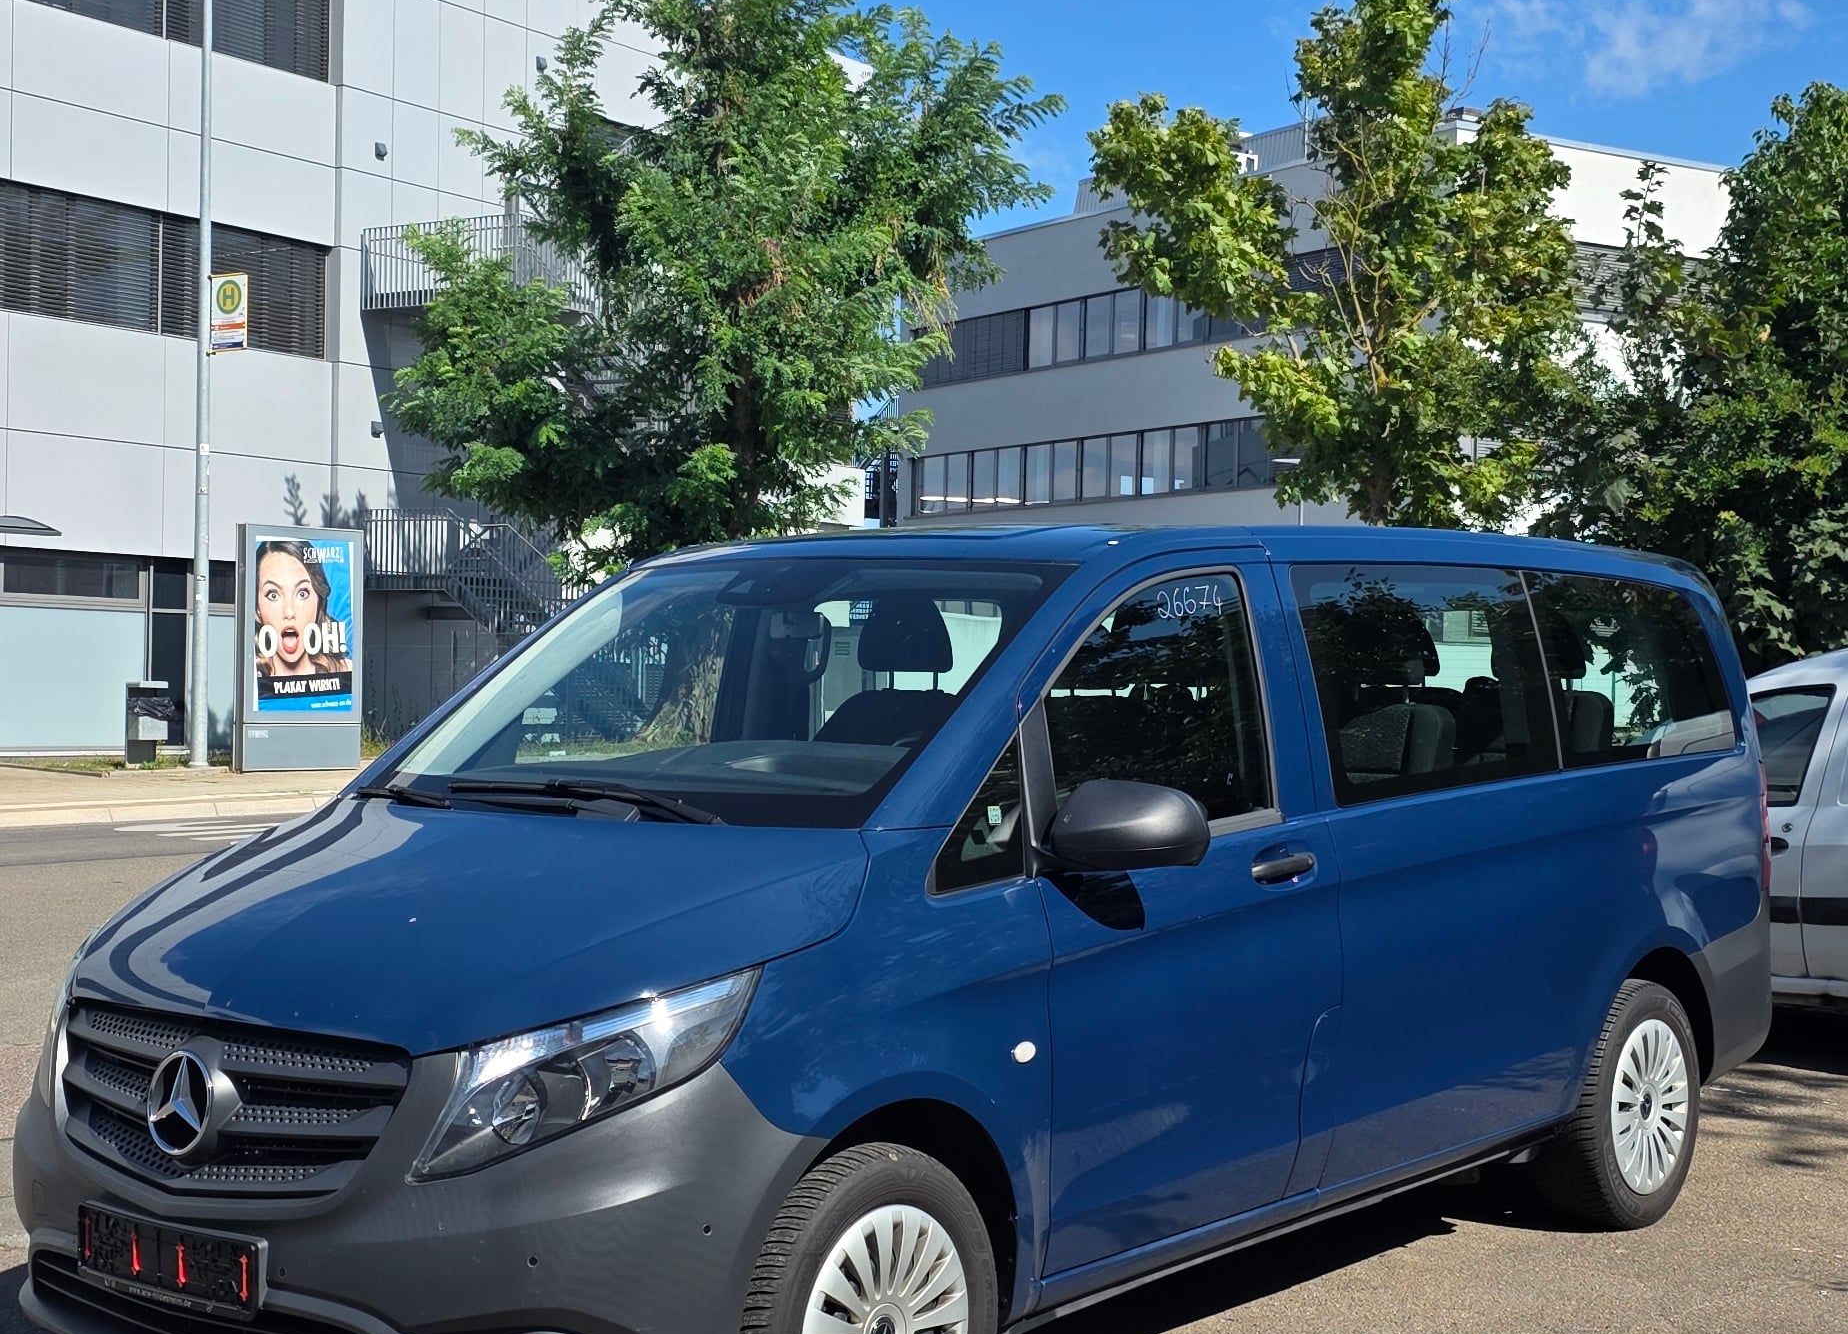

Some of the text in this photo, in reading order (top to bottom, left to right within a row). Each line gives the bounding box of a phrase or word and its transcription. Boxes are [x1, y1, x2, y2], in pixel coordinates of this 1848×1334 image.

[223, 287, 235, 307] H
[303, 547, 340, 563] SCHWARZ
[1157, 584, 1223, 619] 26674
[273, 681, 307, 694] PLAKAT
